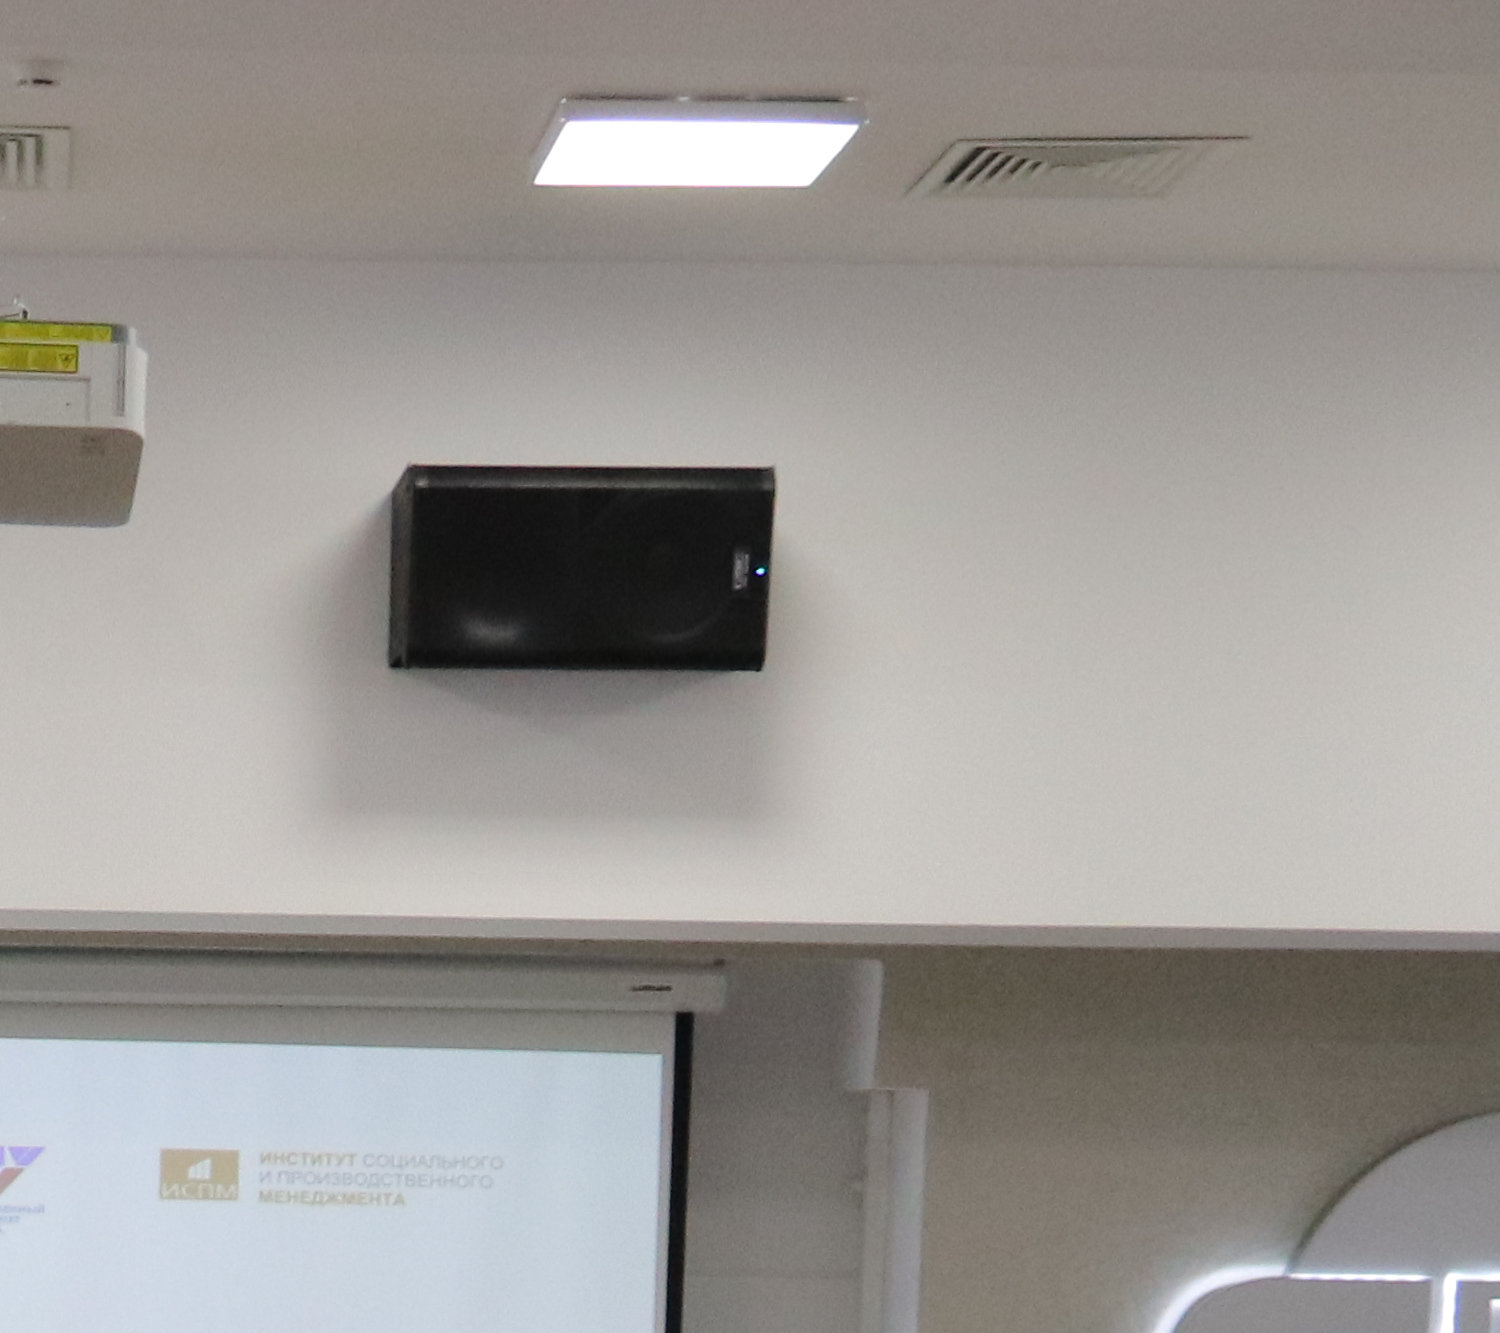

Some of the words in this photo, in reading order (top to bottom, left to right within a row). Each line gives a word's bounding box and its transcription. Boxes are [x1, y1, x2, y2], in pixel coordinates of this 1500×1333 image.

[260, 1152, 356, 1167] ИНСТИТУТ
[363, 1153, 504, 1170] СОЦИАЛЬНОГО
[260, 1171, 271, 1184] И
[278, 1171, 494, 1189] ПРОИЗВОДСТВЕННОГО
[161, 1183, 237, 1199] ИСПМ
[259, 1190, 405, 1206] МЕНЕДЖМЕНТА
